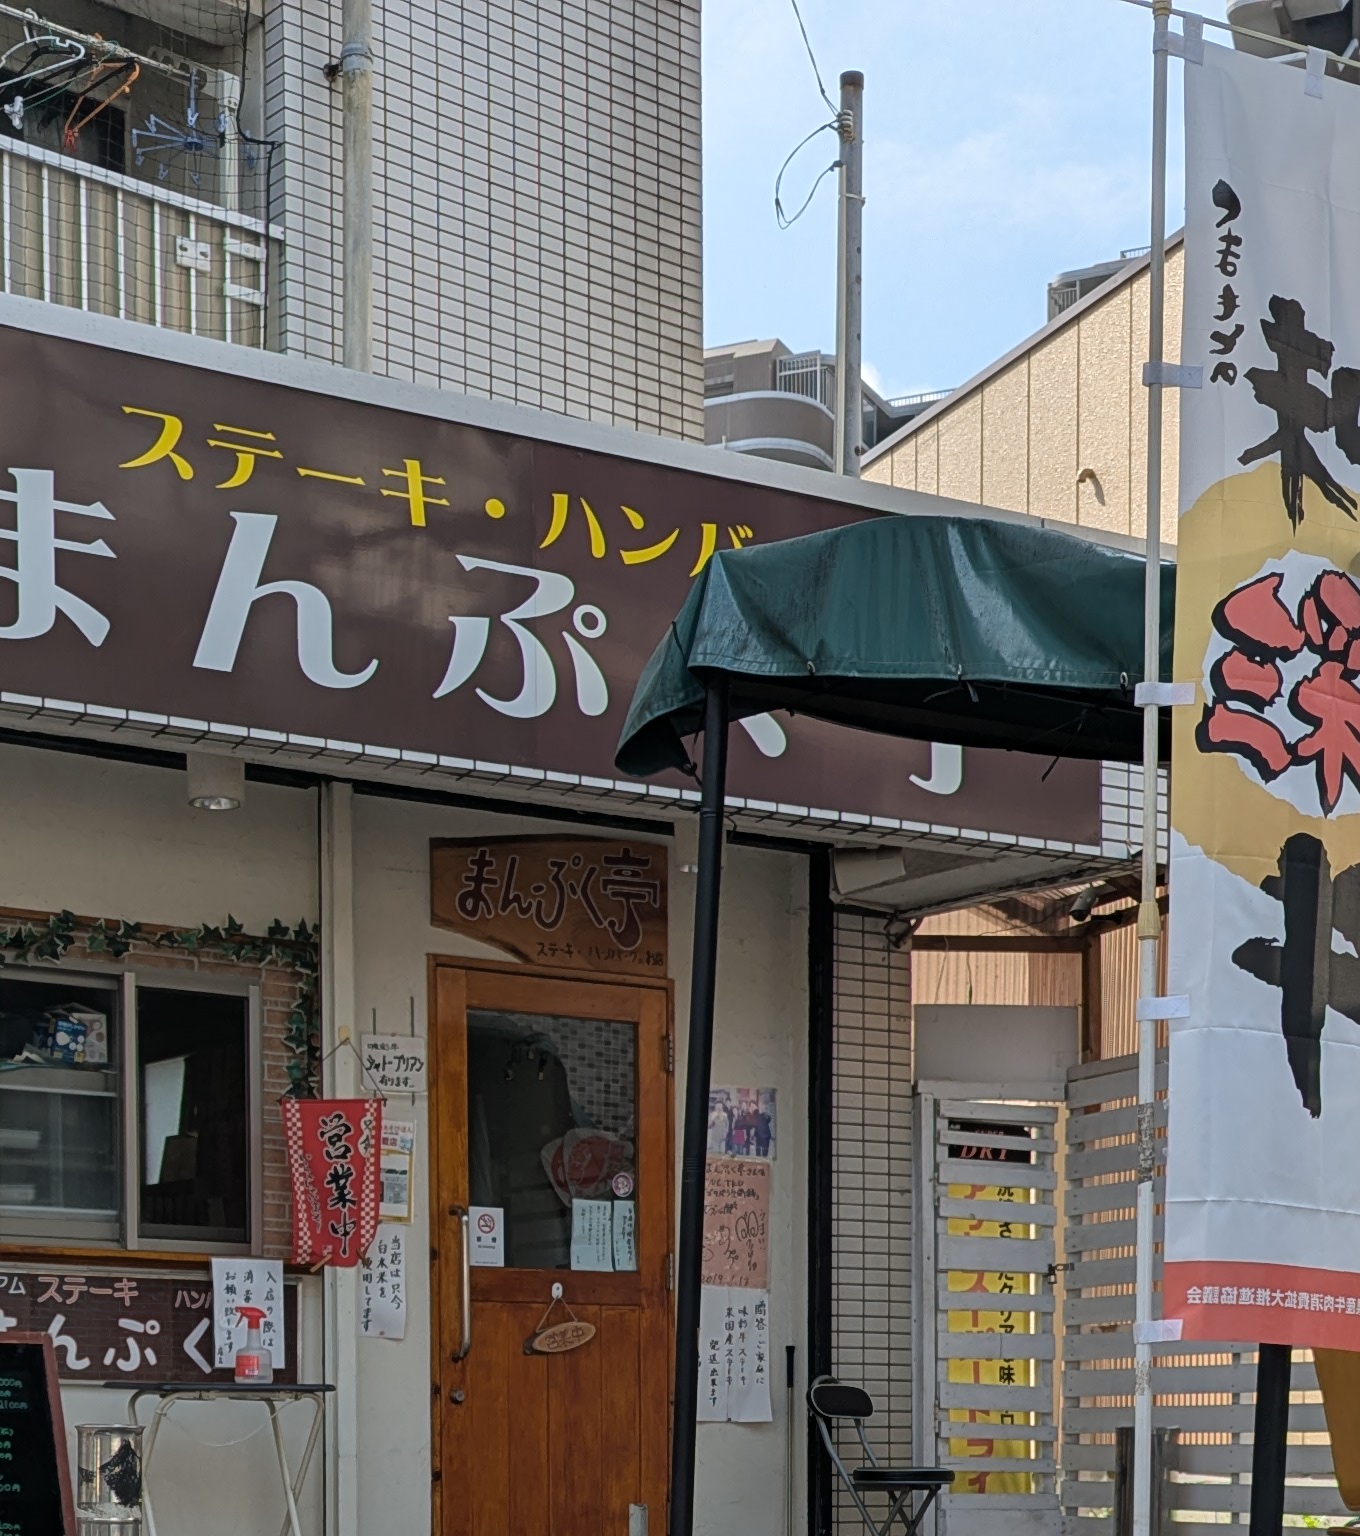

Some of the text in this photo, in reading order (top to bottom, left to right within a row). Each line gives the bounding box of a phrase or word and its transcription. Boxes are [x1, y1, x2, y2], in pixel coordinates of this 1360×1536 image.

[456, 847, 661, 950] まんぷく亭
[318, 1112, 359, 1257] 営業中
[37, 1276, 140, 1307] ステーキ
[175, 1289, 211, 1309] ハン
